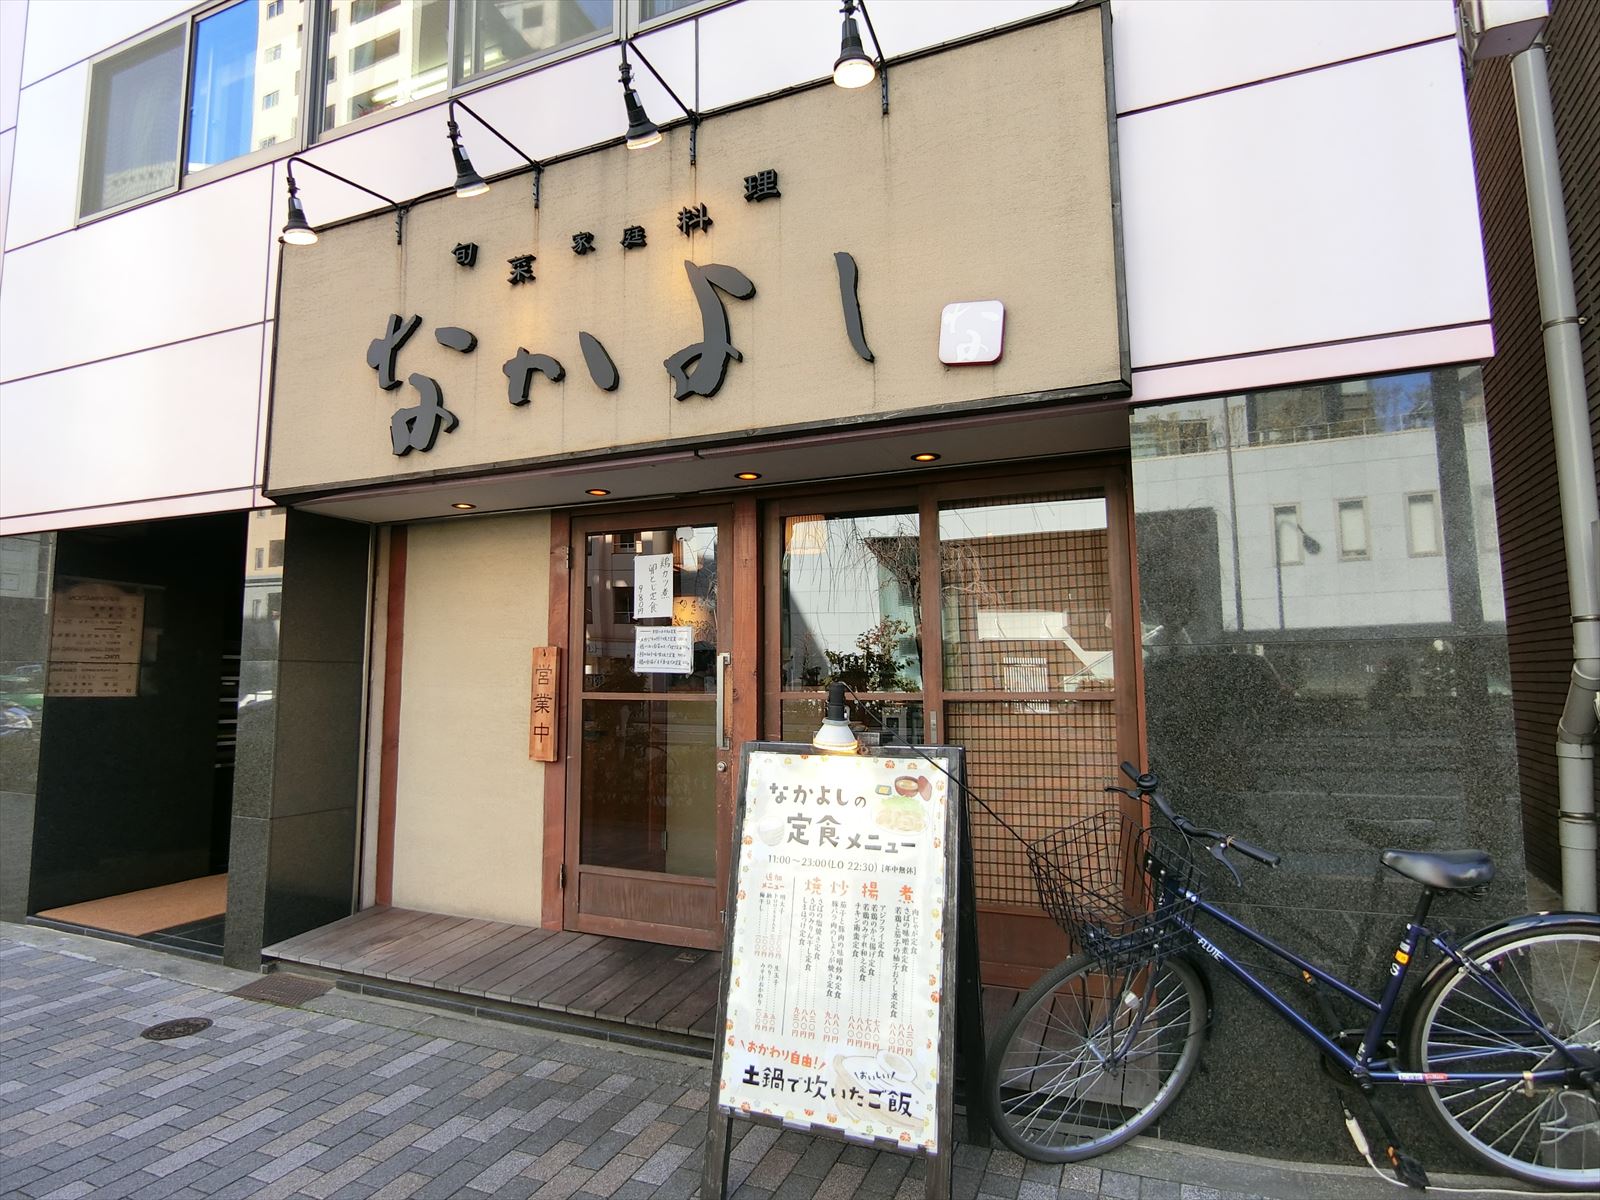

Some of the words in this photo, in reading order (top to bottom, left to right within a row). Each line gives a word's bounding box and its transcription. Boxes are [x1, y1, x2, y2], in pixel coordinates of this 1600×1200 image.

[451, 168, 782, 287] 旬菜家庭料理
[366, 251, 875, 457] なかよし
[533, 664, 553, 743] 営業中
[769, 782, 867, 809] なかよしの
[787, 812, 917, 854] 定食メニュー
[761, 881, 785, 890] メニュー
[804, 875, 823, 896] 焼
[830, 880, 849, 897] 炒
[861, 881, 879, 901] 揚
[898, 884, 914, 905] 煮
[1197, 937, 1224, 963] FLUTE
[742, 1064, 912, 1117] 土鍋で炊いたご飯
